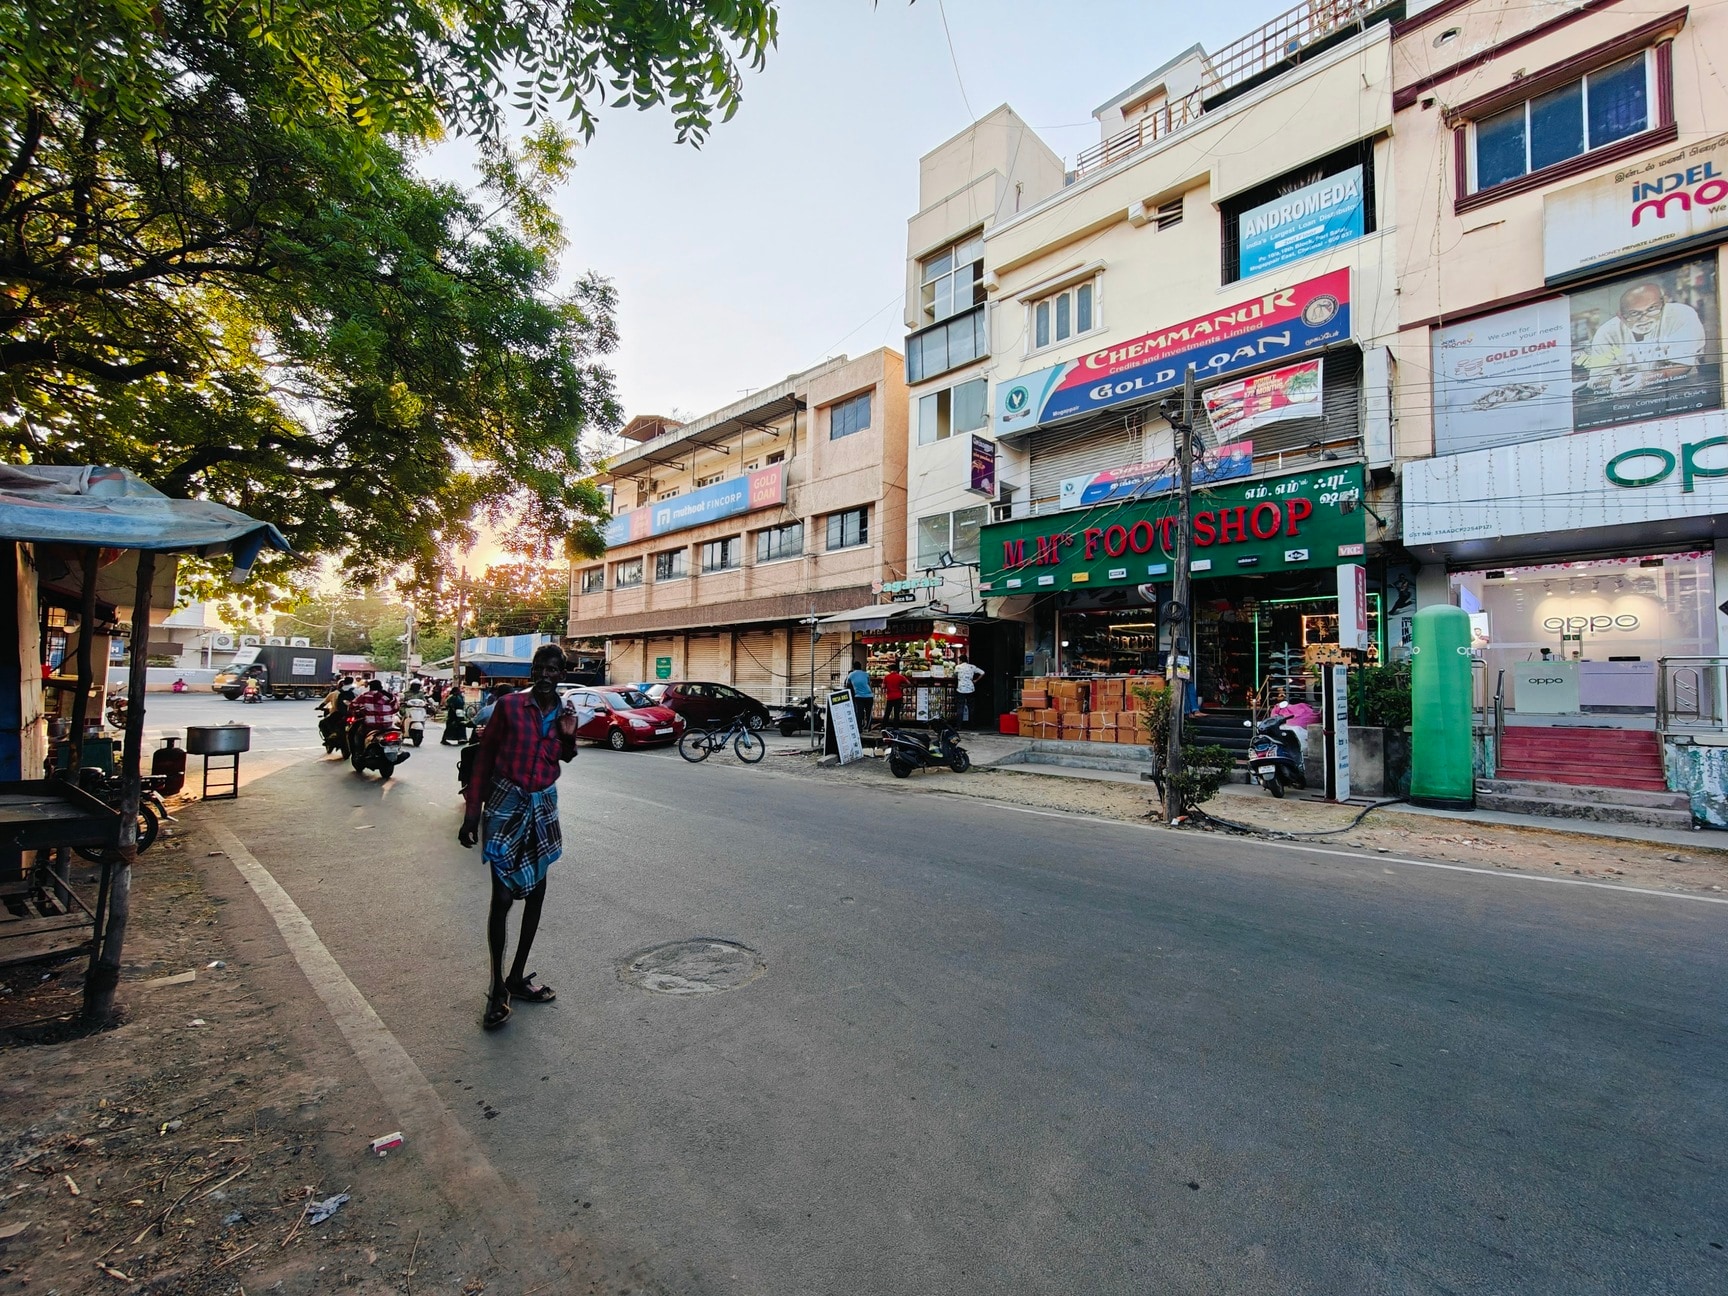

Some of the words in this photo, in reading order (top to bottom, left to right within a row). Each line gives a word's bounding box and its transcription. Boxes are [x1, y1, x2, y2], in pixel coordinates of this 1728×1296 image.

[1245, 178, 1360, 240] ANDROMEDA
[1709, 205, 1727, 214] We
[1246, 237, 1267, 250] India's
[1270, 227, 1296, 242] Largest
[1298, 219, 1316, 230] Loan
[1598, 247, 1621, 258] MONEY
[1621, 240, 1648, 252] PRIVATE
[1648, 232, 1676, 244] LIMITED
[1487, 333, 1500, 341] We
[1501, 329, 1517, 338] care
[1518, 325, 1530, 334] for
[1519, 331, 1537, 341] your
[1539, 324, 1563, 335] needs
[1109, 360, 1141, 375] Credits
[1142, 353, 1160, 365] and
[1161, 336, 1221, 359] Investments
[1223, 321, 1264, 340] Limited
[1485, 349, 1519, 363] GOLD
[1521, 339, 1557, 355] LOAN
[1089, 368, 1176, 401] GOLD
[1187, 330, 1291, 374] LOAN
[1052, 405, 1081, 417] Mogappair
[1612, 404, 1631, 412] Easy
[1635, 394, 1679, 407] Convenient
[753, 473, 777, 489] GOLD
[753, 486, 776, 503] LOAN
[672, 500, 705, 519] muthoot
[706, 491, 742, 511] FINCORP
[1083, 515, 1180, 561] FOOT
[1193, 496, 1312, 547] SHOP
[1340, 546, 1361, 555] VKC
[1401, 628, 1409, 636] IN
[1543, 614, 1639, 634] oppo
[1528, 677, 1564, 685] oppo
